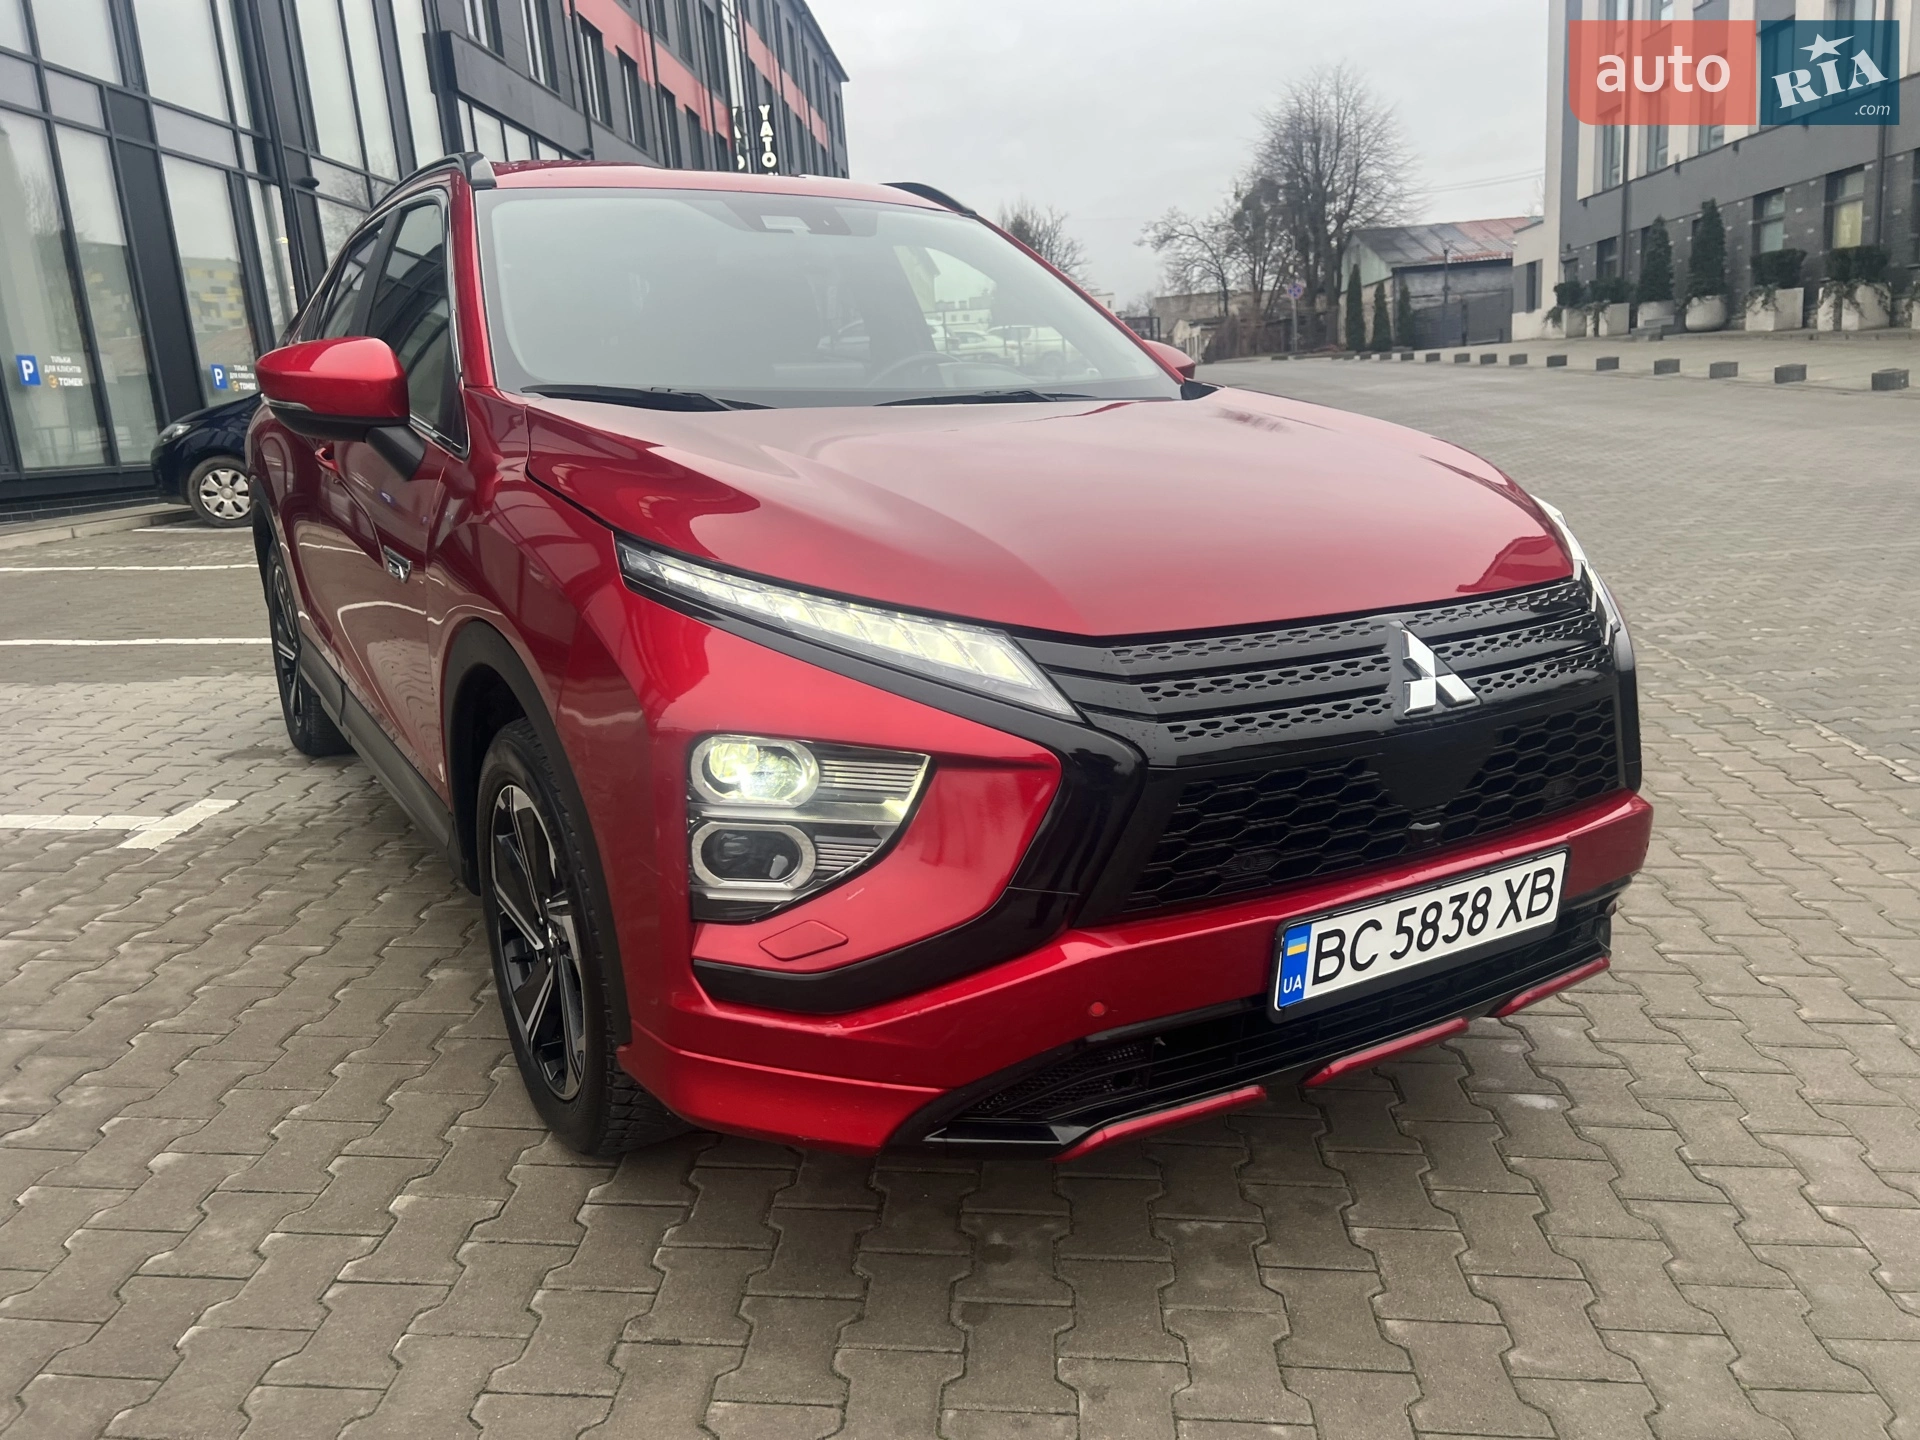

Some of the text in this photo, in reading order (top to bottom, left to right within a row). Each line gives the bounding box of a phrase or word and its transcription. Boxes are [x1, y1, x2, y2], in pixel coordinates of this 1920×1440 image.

[758, 104, 777, 168] YATO
[21, 359, 34, 382] P
[214, 368, 223, 386] P
[1311, 867, 1556, 986] BC 5838 XB
[1283, 973, 1303, 994] UA
